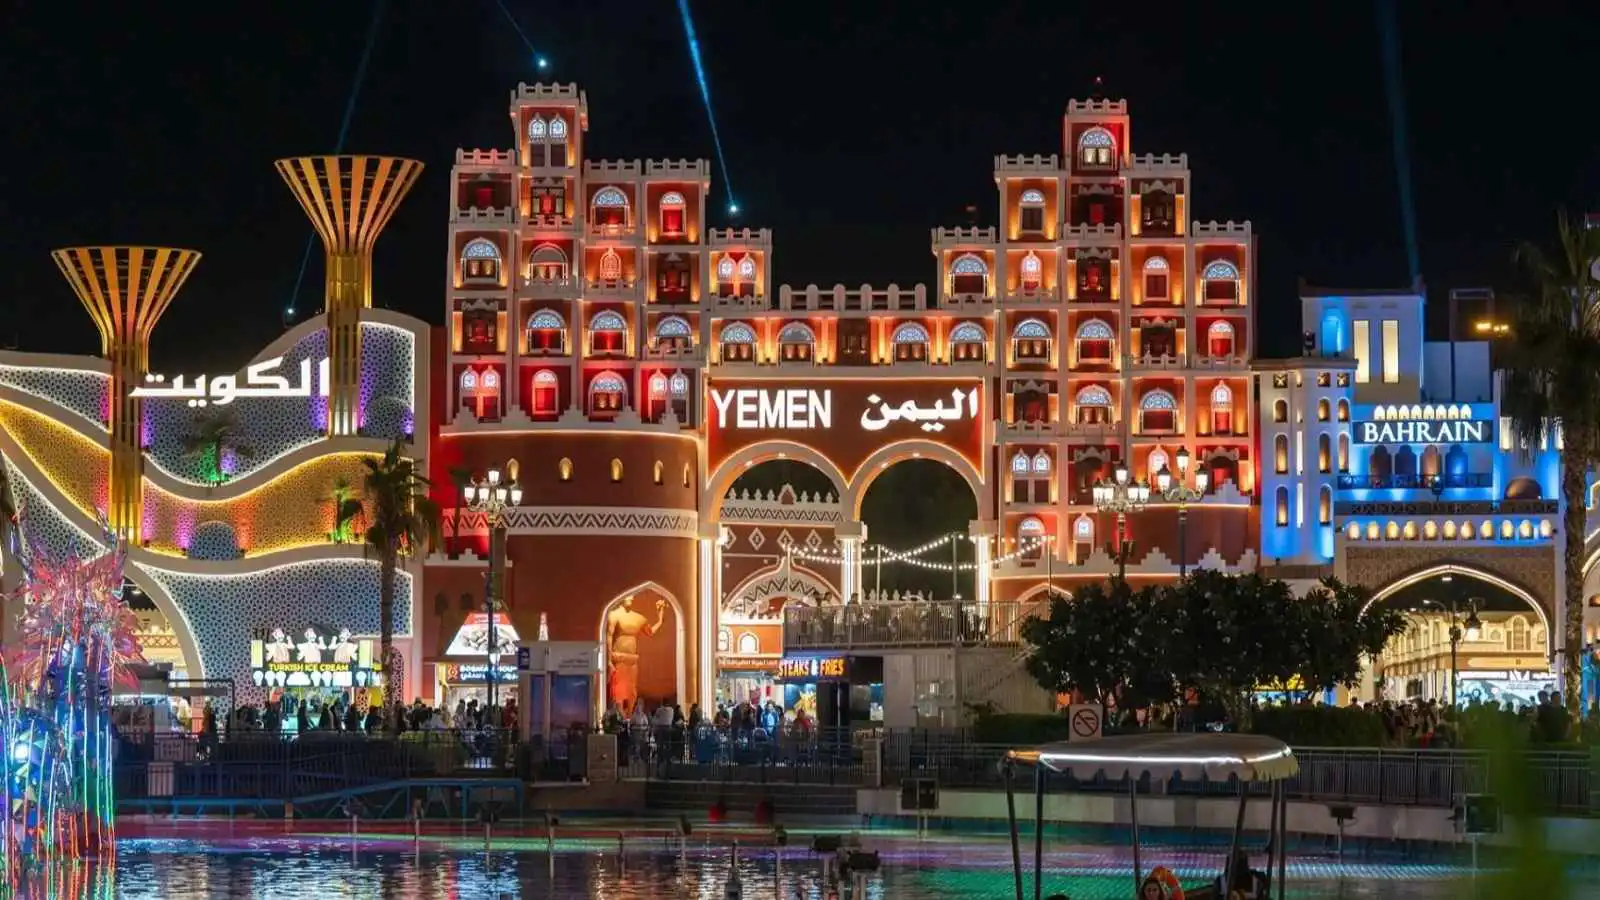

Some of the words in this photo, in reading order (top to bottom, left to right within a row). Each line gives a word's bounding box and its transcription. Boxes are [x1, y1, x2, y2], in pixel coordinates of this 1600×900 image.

[128, 357, 330, 407] الكويت
[709, 389, 832, 429] YEMEN
[860, 387, 978, 432] اليمن
[1364, 421, 1484, 442] BAHRAIN
[269, 663, 303, 672] TURKISH
[304, 663, 318, 672] ICE
[320, 663, 349, 672] CREAM
[778, 659, 809, 677] STEAKS
[820, 658, 845, 676] FRIES
